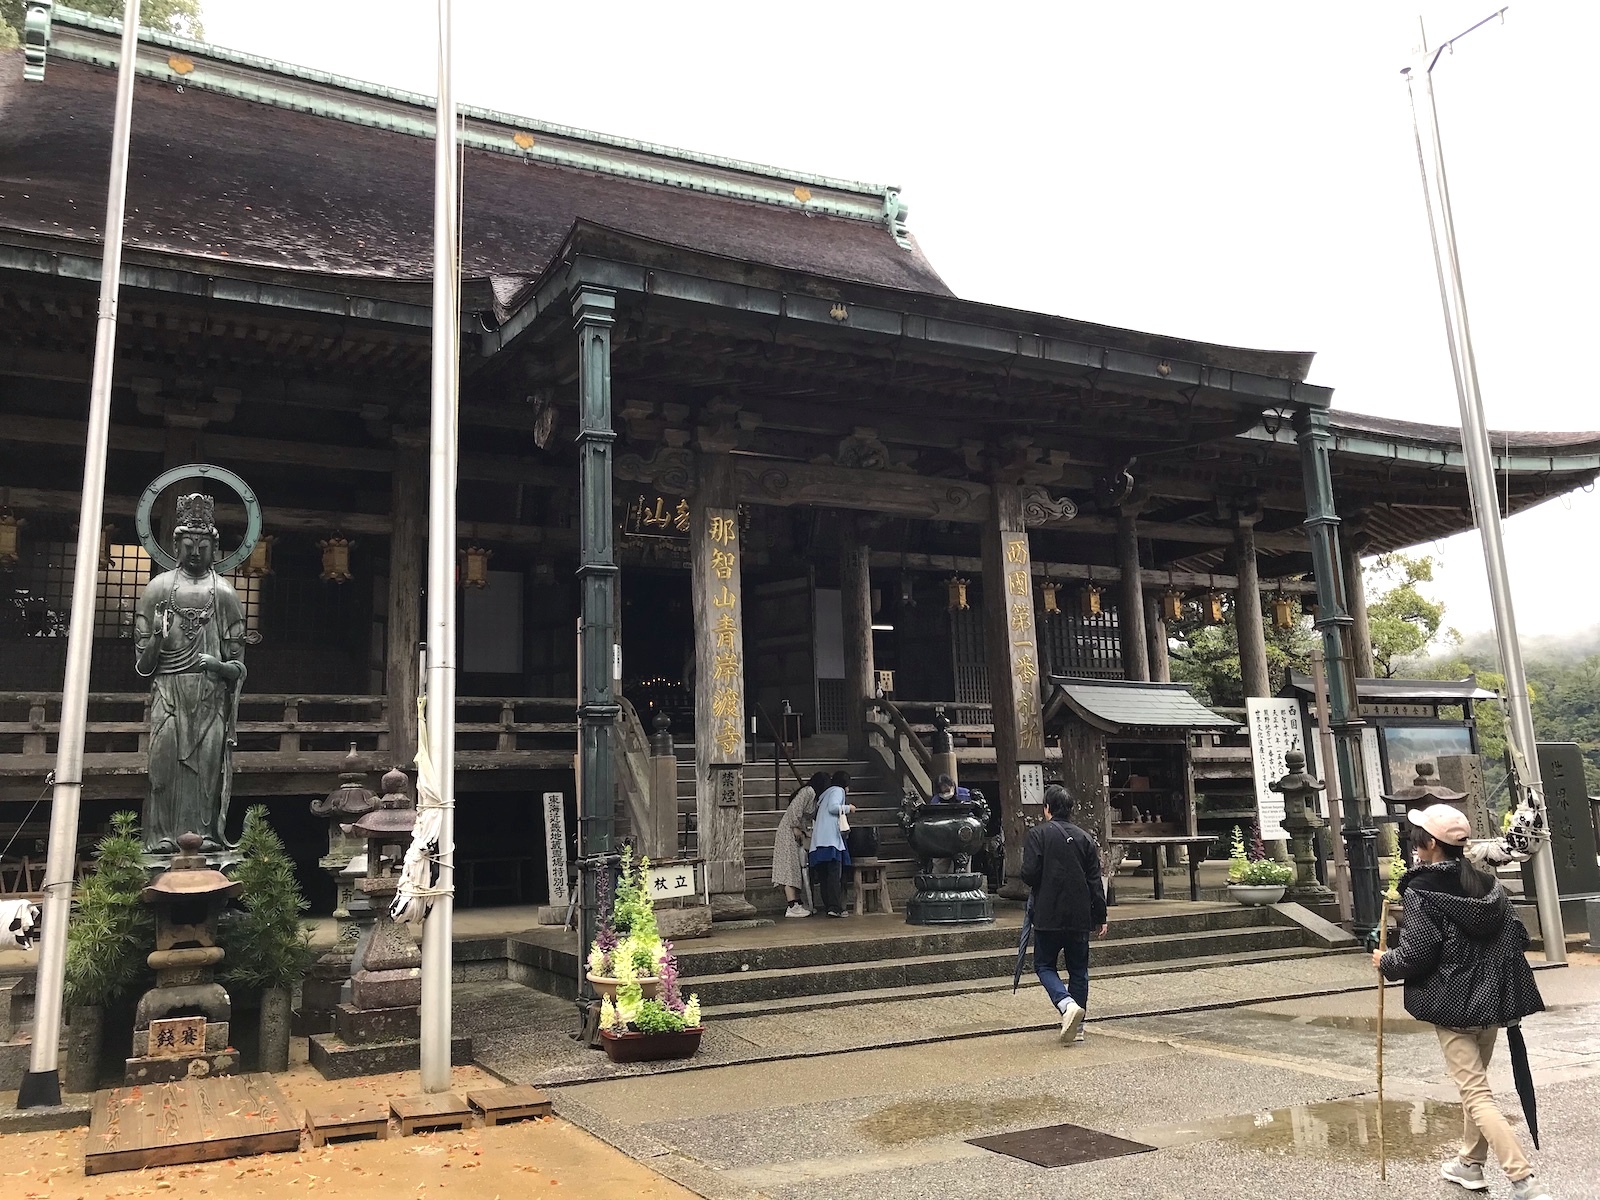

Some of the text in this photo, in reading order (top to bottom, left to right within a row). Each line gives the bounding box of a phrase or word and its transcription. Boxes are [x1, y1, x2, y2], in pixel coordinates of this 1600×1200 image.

[708, 515, 742, 755] 那智山青岸渡寺
[721, 772, 736, 804] 禁煙
